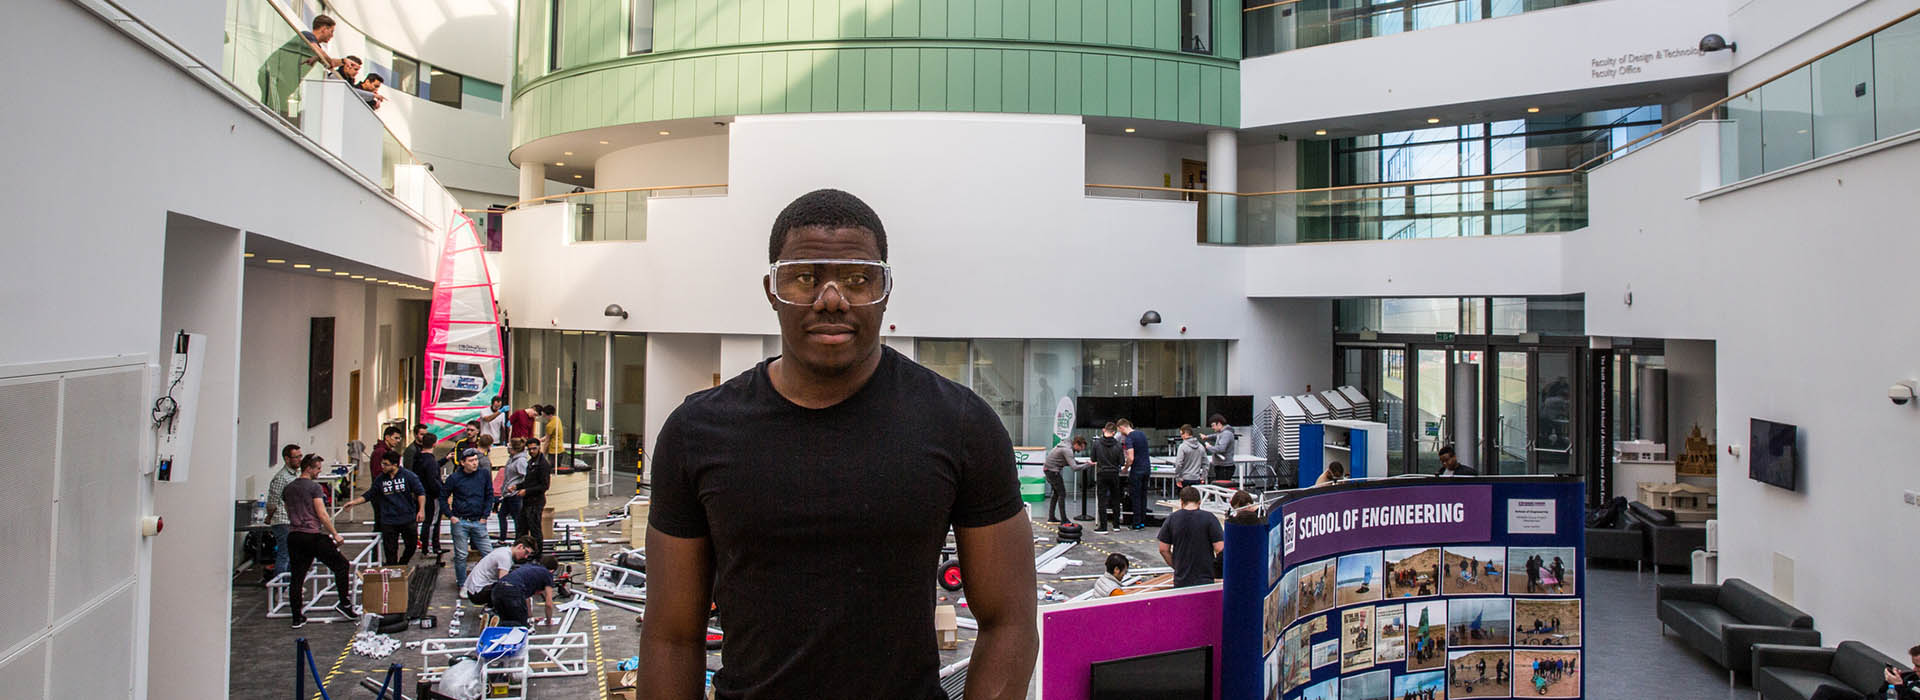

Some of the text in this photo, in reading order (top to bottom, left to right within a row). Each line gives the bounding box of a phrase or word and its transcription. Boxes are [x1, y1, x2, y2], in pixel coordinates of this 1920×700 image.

[1591, 57, 1617, 68] Faculty
[1619, 53, 1628, 64] of
[1628, 53, 1654, 64] Design
[1655, 49, 1663, 60] &
[1591, 64, 1641, 79] Faculty Office
[1299, 503, 1464, 540] SCHOOL OF ENGINEERING
